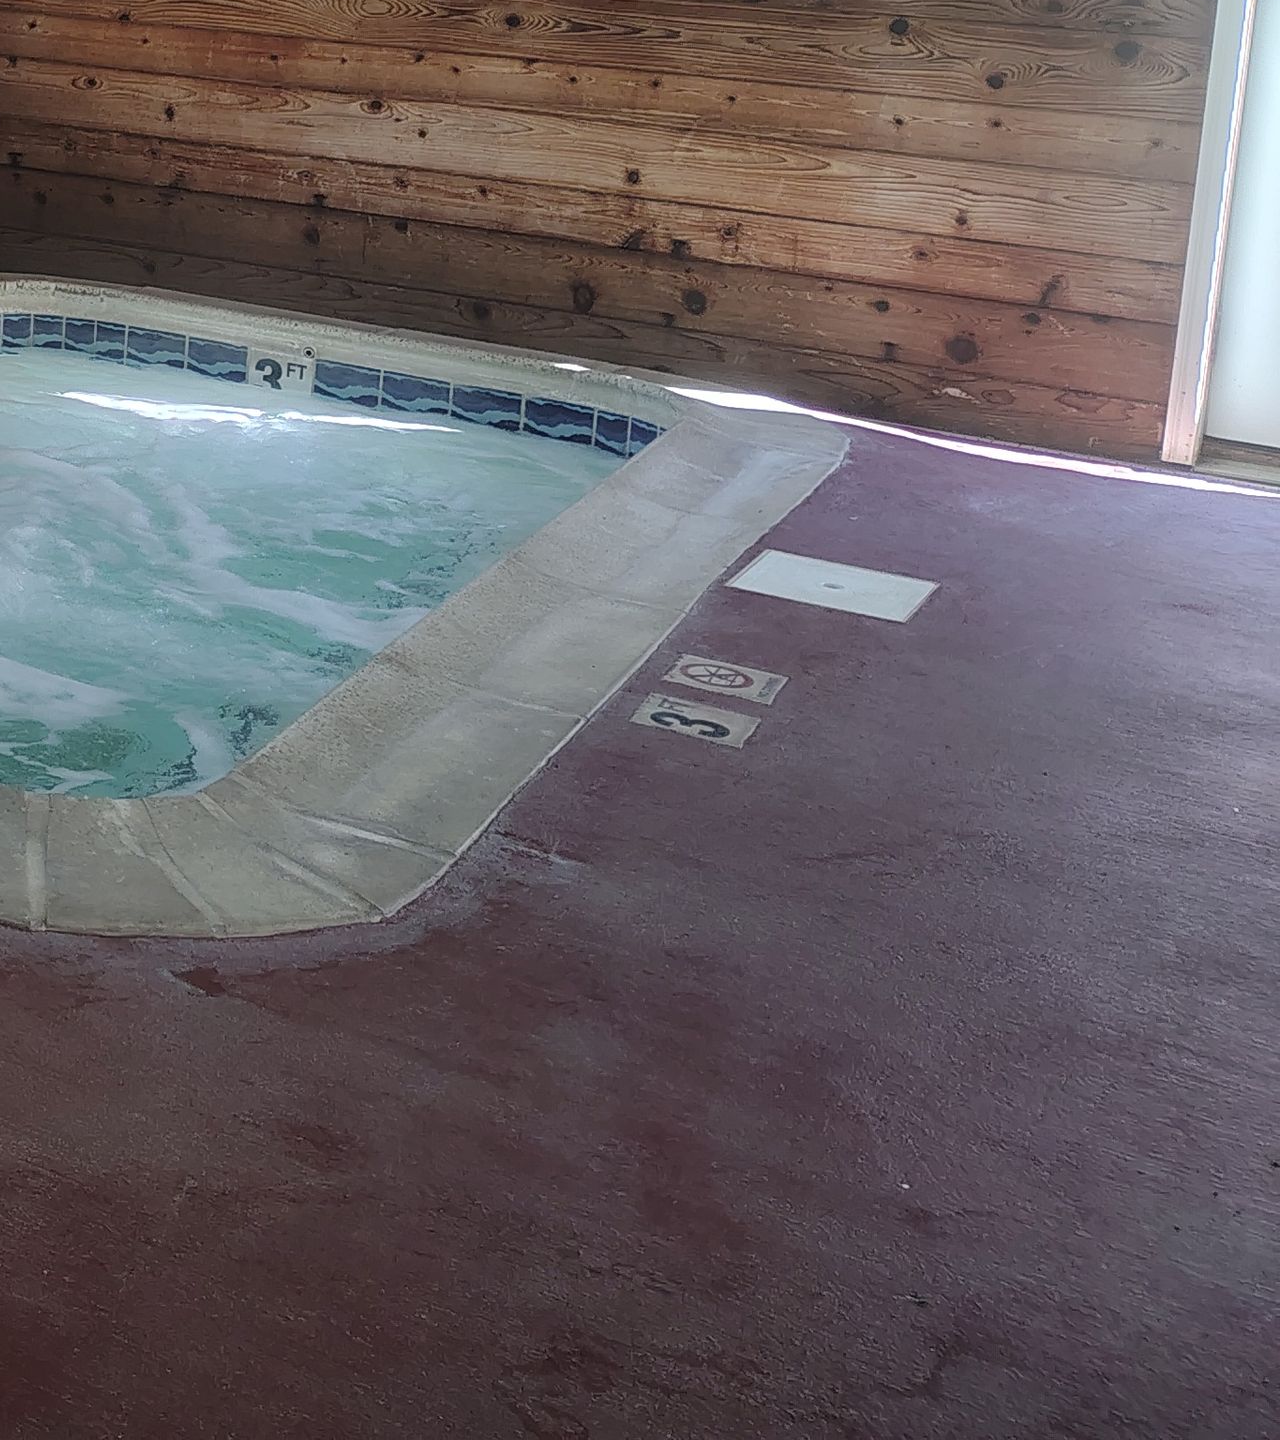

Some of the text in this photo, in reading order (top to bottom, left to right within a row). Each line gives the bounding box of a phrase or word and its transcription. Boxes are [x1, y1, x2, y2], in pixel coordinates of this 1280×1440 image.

[255, 358, 308, 390] 3 FT
[650, 711, 730, 738] 3
